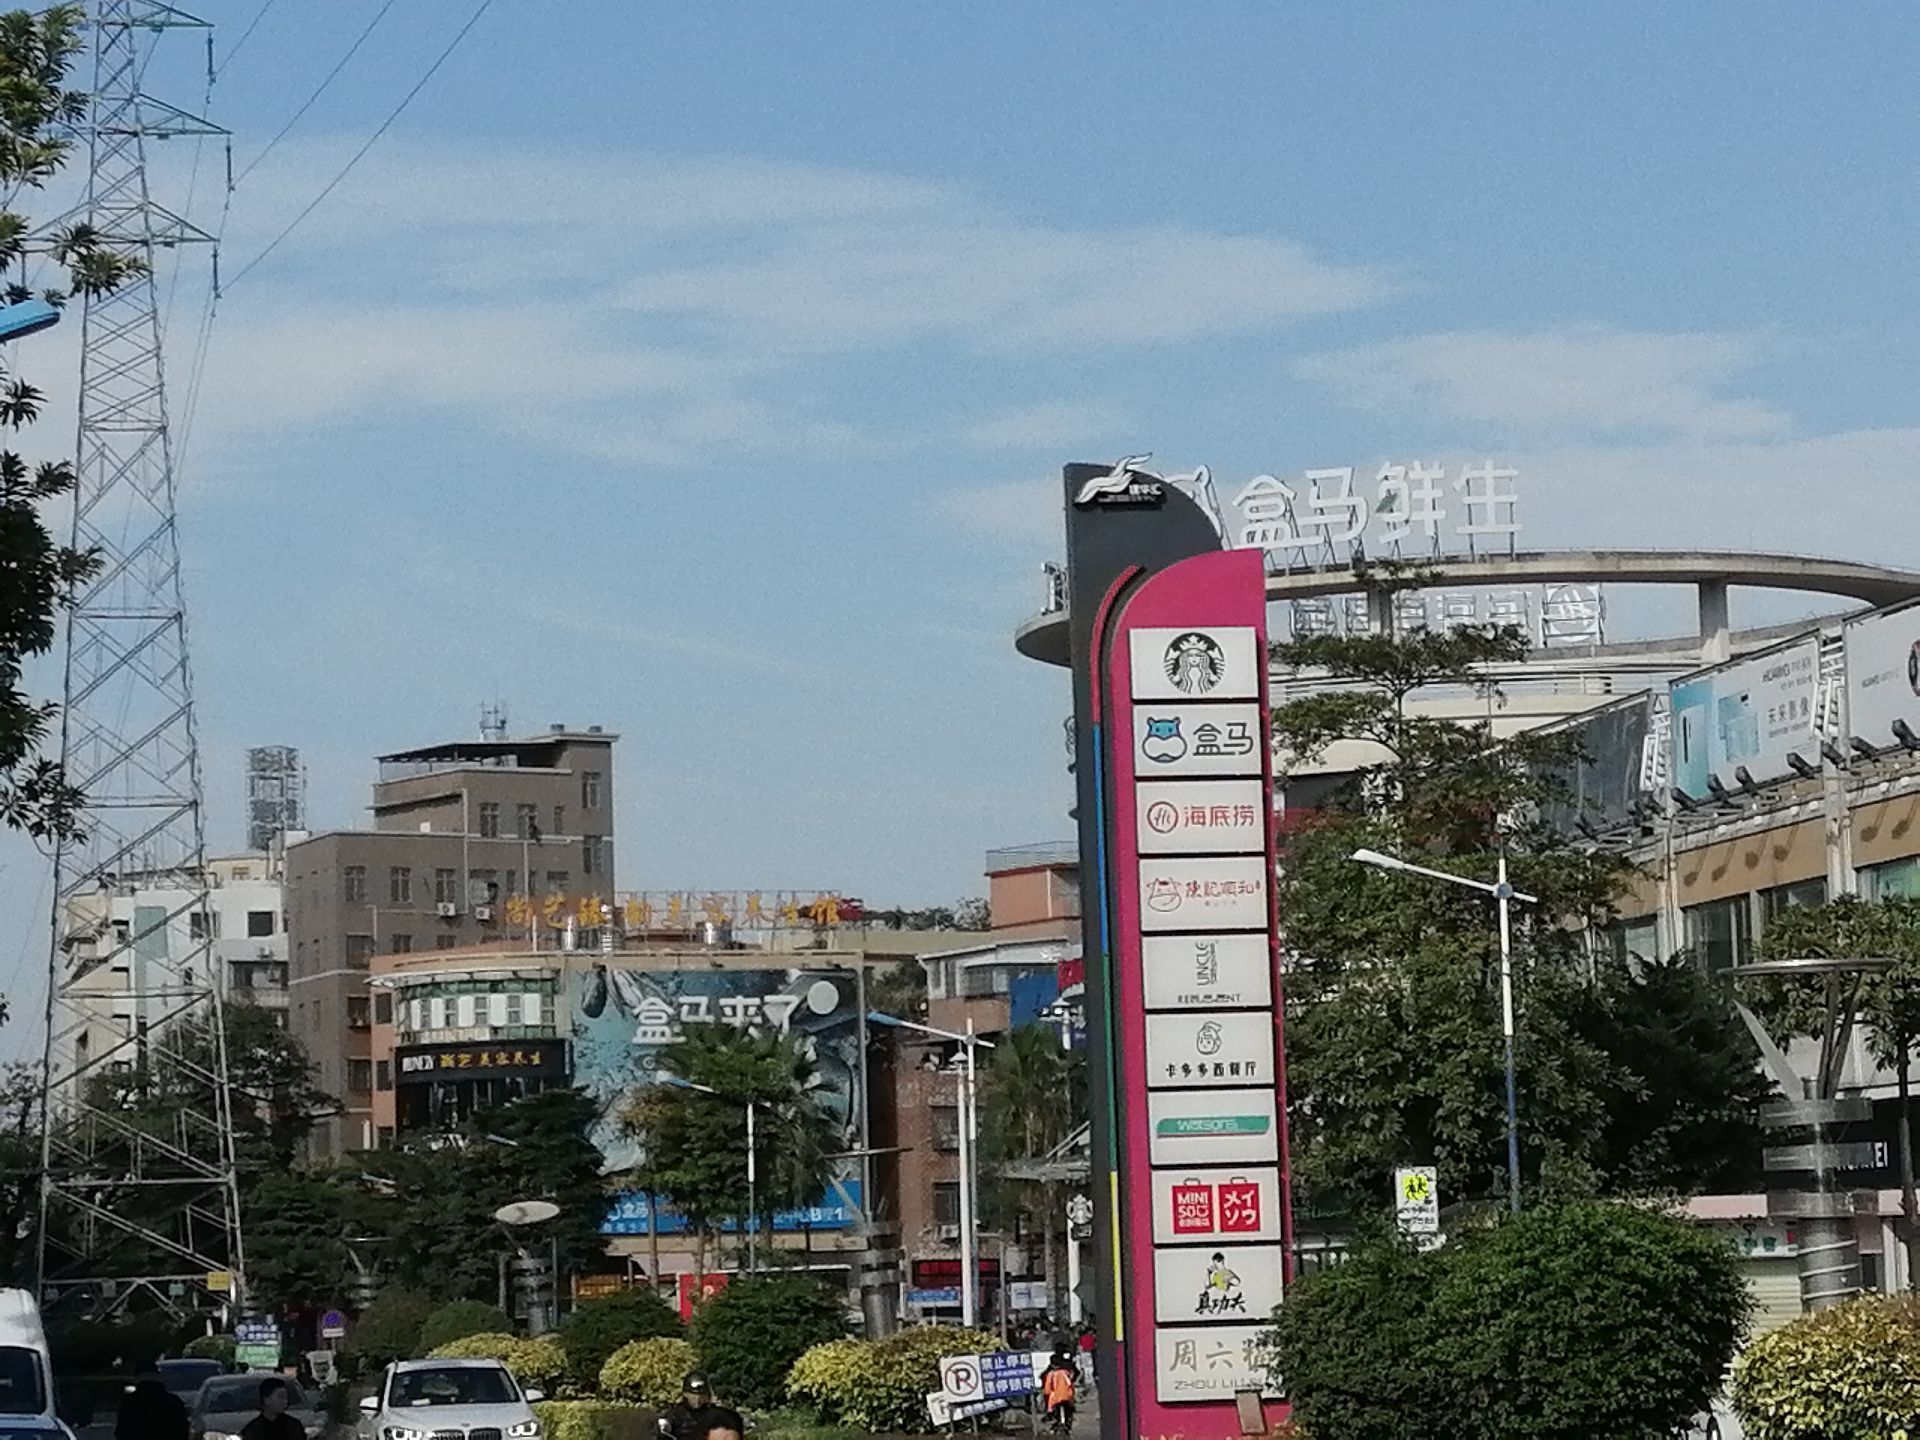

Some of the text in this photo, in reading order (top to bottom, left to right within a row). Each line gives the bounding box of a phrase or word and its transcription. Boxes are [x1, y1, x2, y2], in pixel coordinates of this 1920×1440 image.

[1232, 460, 1524, 550] 盒马鲜生
[1192, 722, 1254, 757] 盒马
[1183, 804, 1256, 828] 海底捞
[1194, 1290, 1246, 1315] 真功夫
